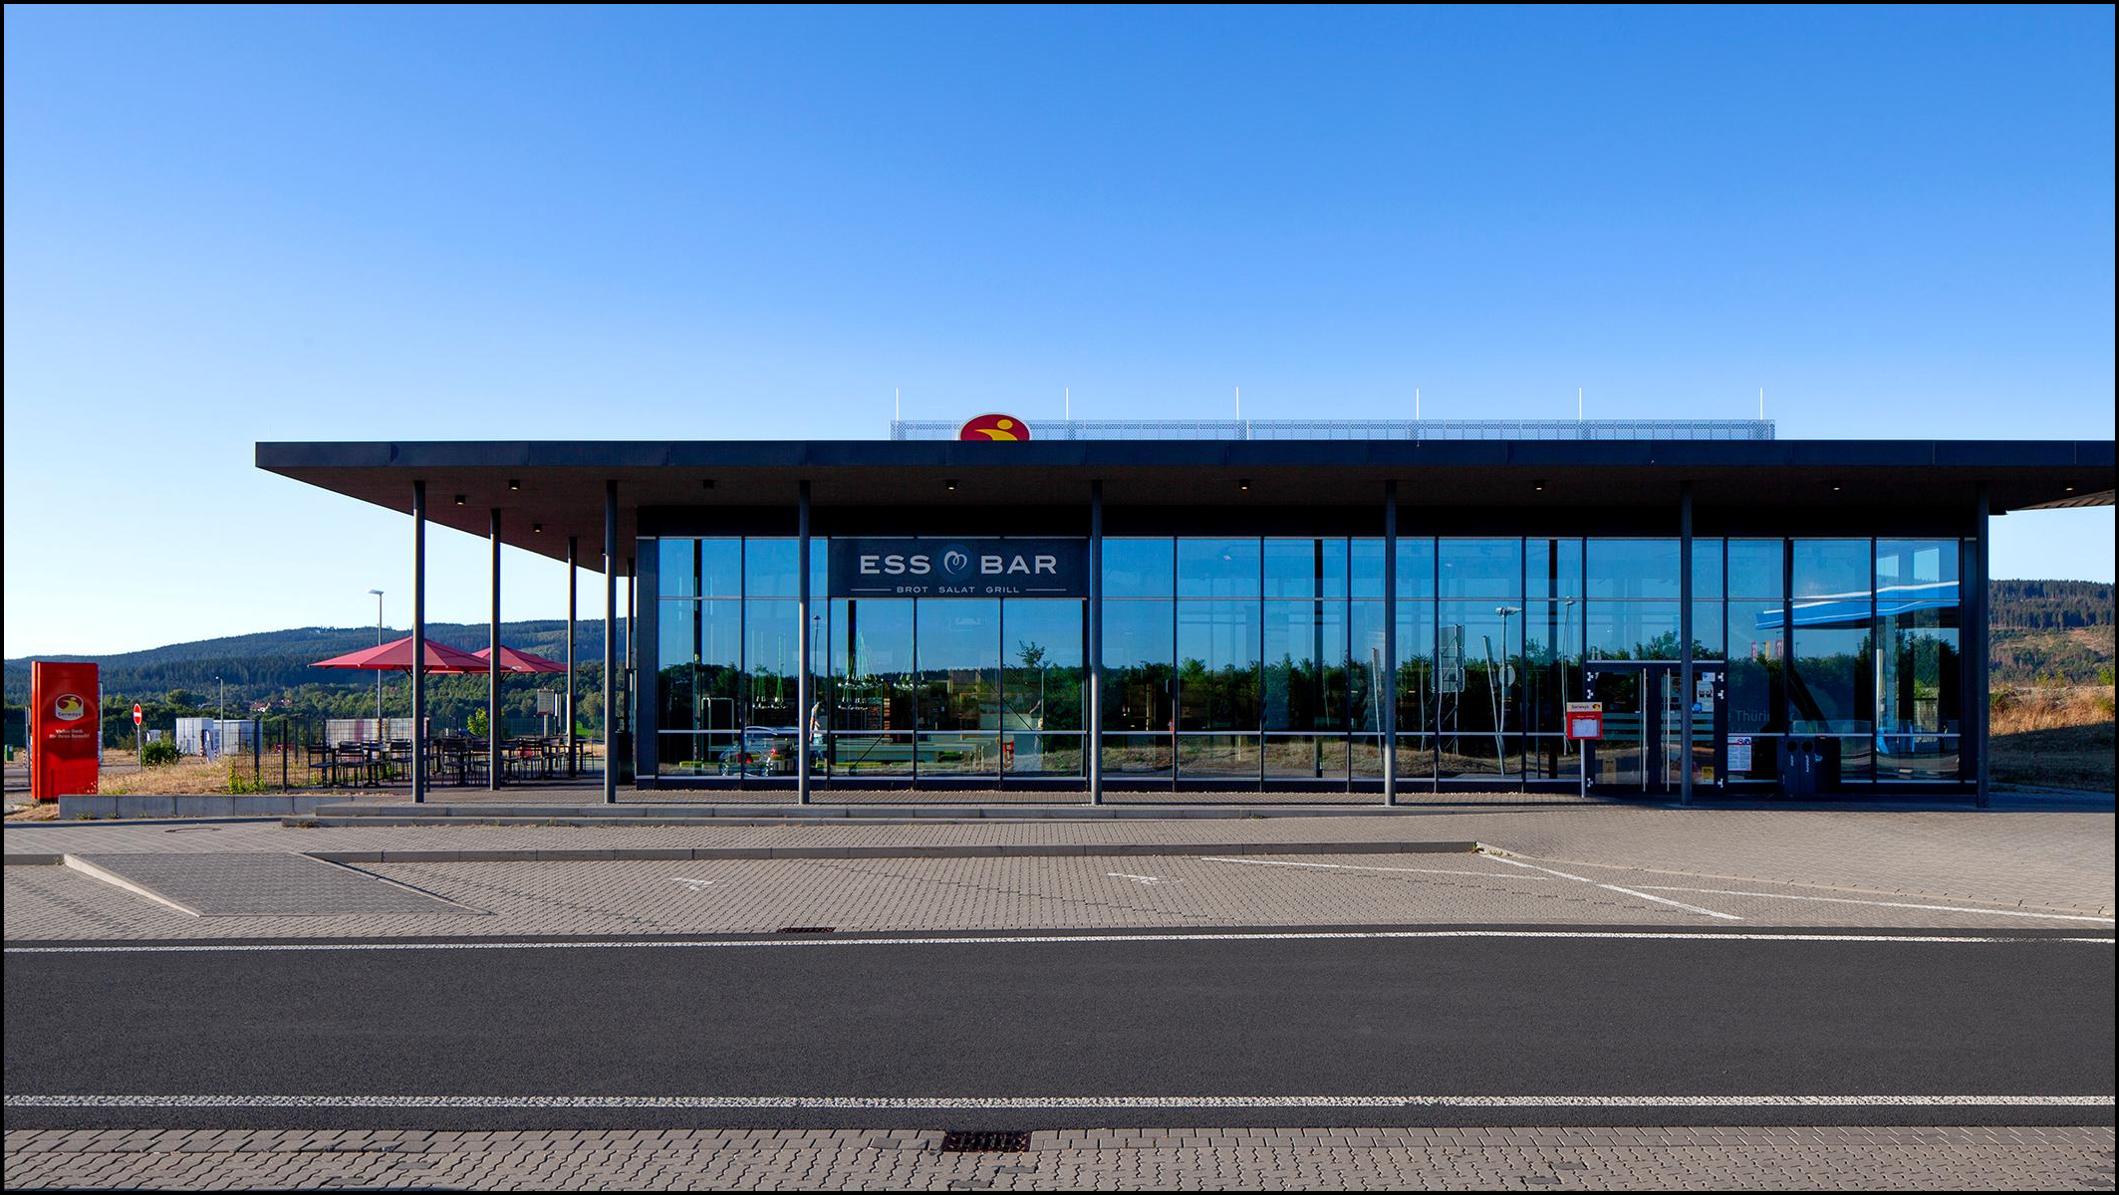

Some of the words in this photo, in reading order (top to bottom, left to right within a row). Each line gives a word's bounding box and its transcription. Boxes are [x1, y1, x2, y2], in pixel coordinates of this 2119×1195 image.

[860, 555, 931, 575] ESS
[980, 555, 1057, 575] BAR
[896, 586, 929, 594] BROT
[938, 586, 976, 594] SALAT
[985, 586, 1020, 594] GRILL
